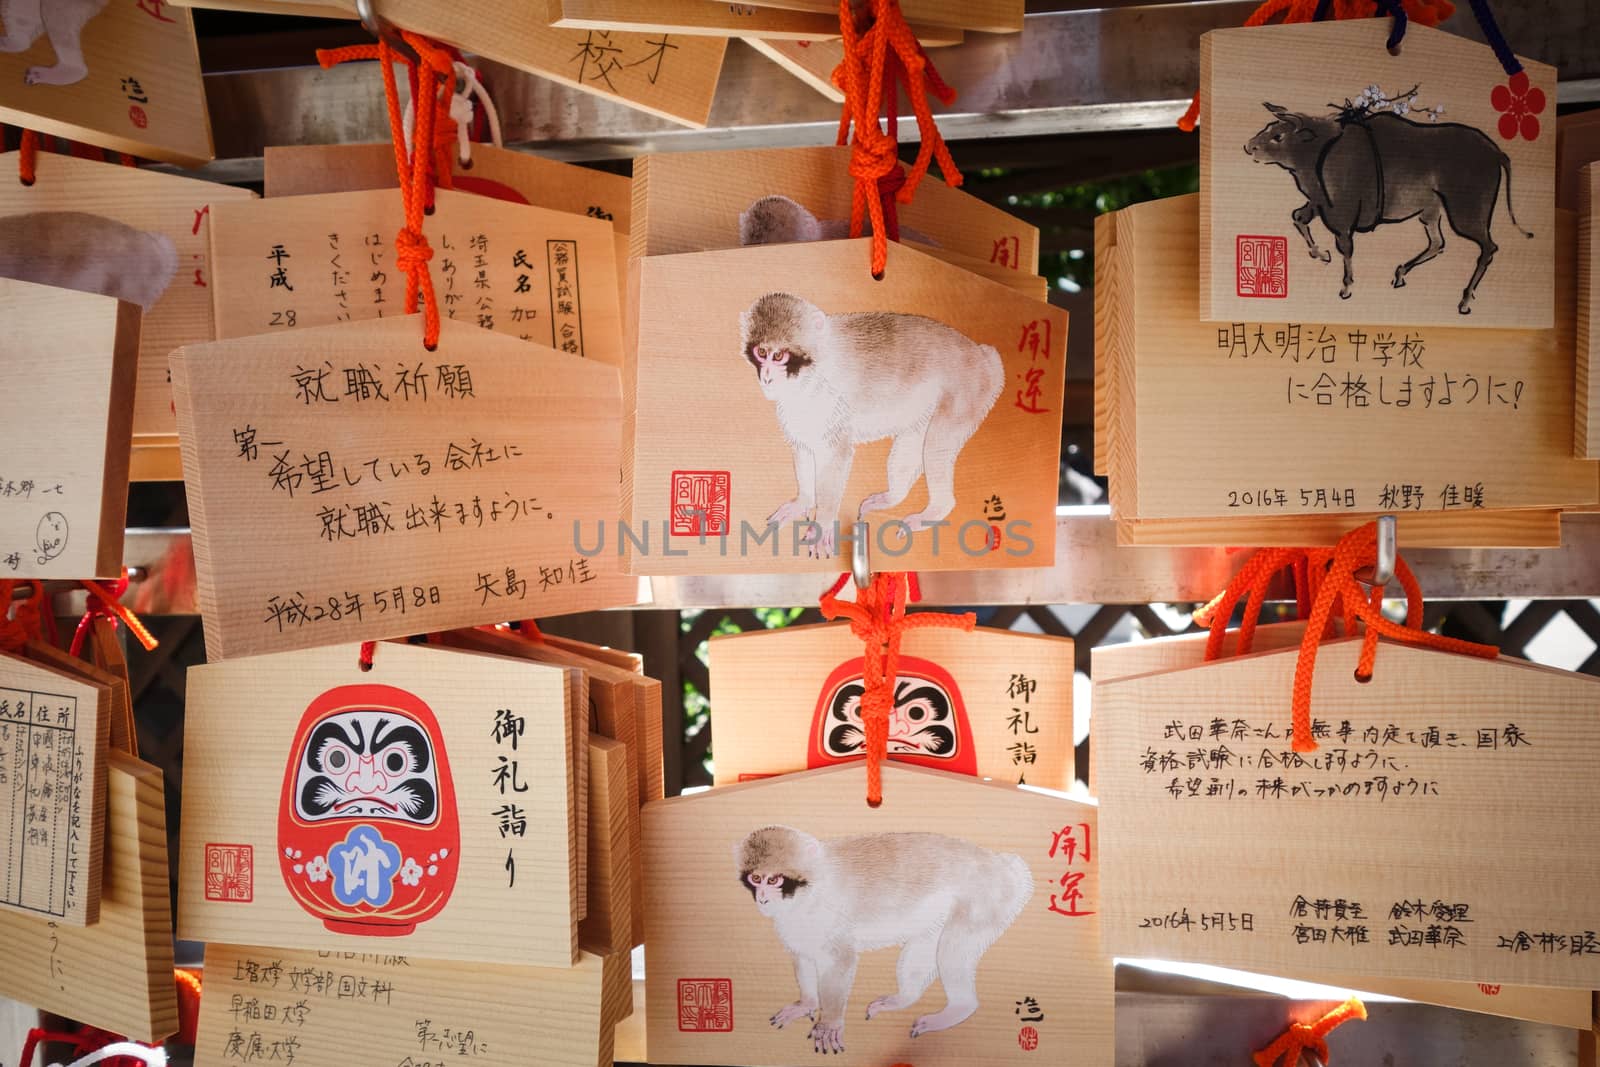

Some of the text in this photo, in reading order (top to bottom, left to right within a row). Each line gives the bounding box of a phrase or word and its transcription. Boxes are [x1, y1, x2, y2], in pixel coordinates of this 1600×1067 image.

[269, 244, 294, 293] 平成
[512, 250, 534, 294] 氏名
[269, 312, 297, 327] 28
[291, 361, 476, 405] 就職祈願
[1378, 482, 1424, 511] 秋野
[263, 585, 441, 633] 平成28年5月8日
[0, 699, 25, 719] 氏名
[36, 705, 70, 728] 住所
[490, 709, 529, 888] 御礼詣り
[1047, 823, 1096, 917] 開運
